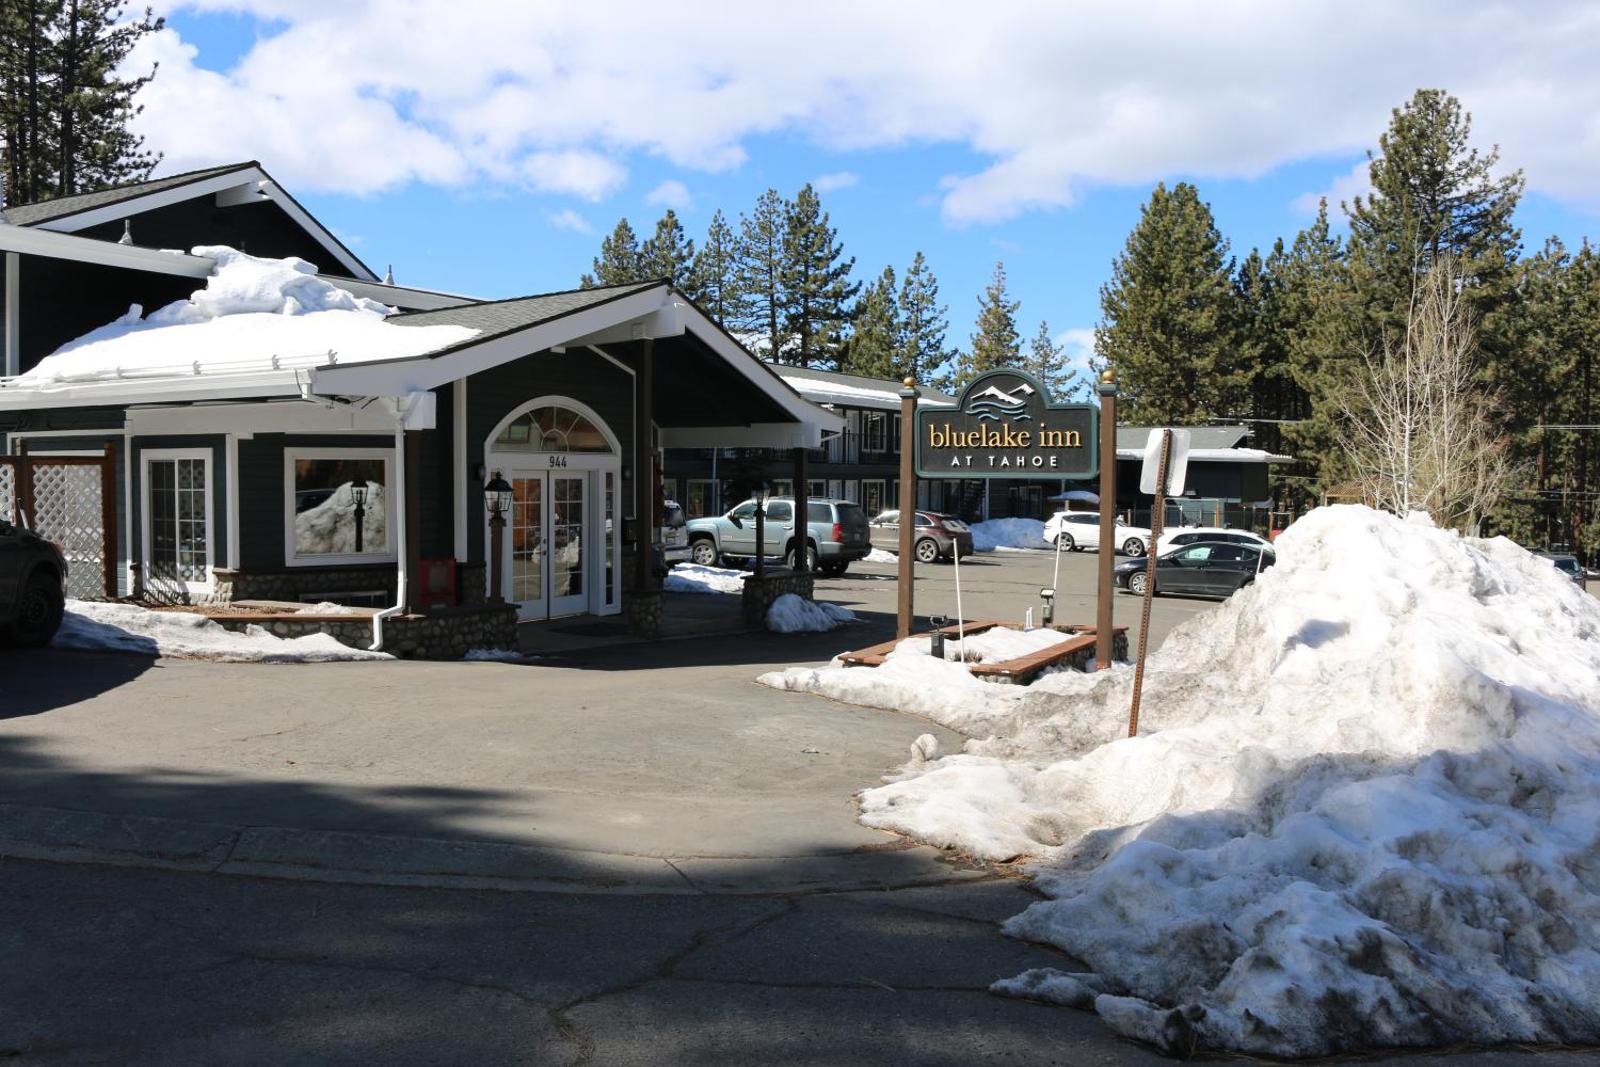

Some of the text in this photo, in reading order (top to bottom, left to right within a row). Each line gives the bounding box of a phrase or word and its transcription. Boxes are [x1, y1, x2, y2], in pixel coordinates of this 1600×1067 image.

[929, 423, 1082, 448] bluelake inn
[549, 455, 567, 468] 944
[951, 456, 1058, 467] AT TAHOE
